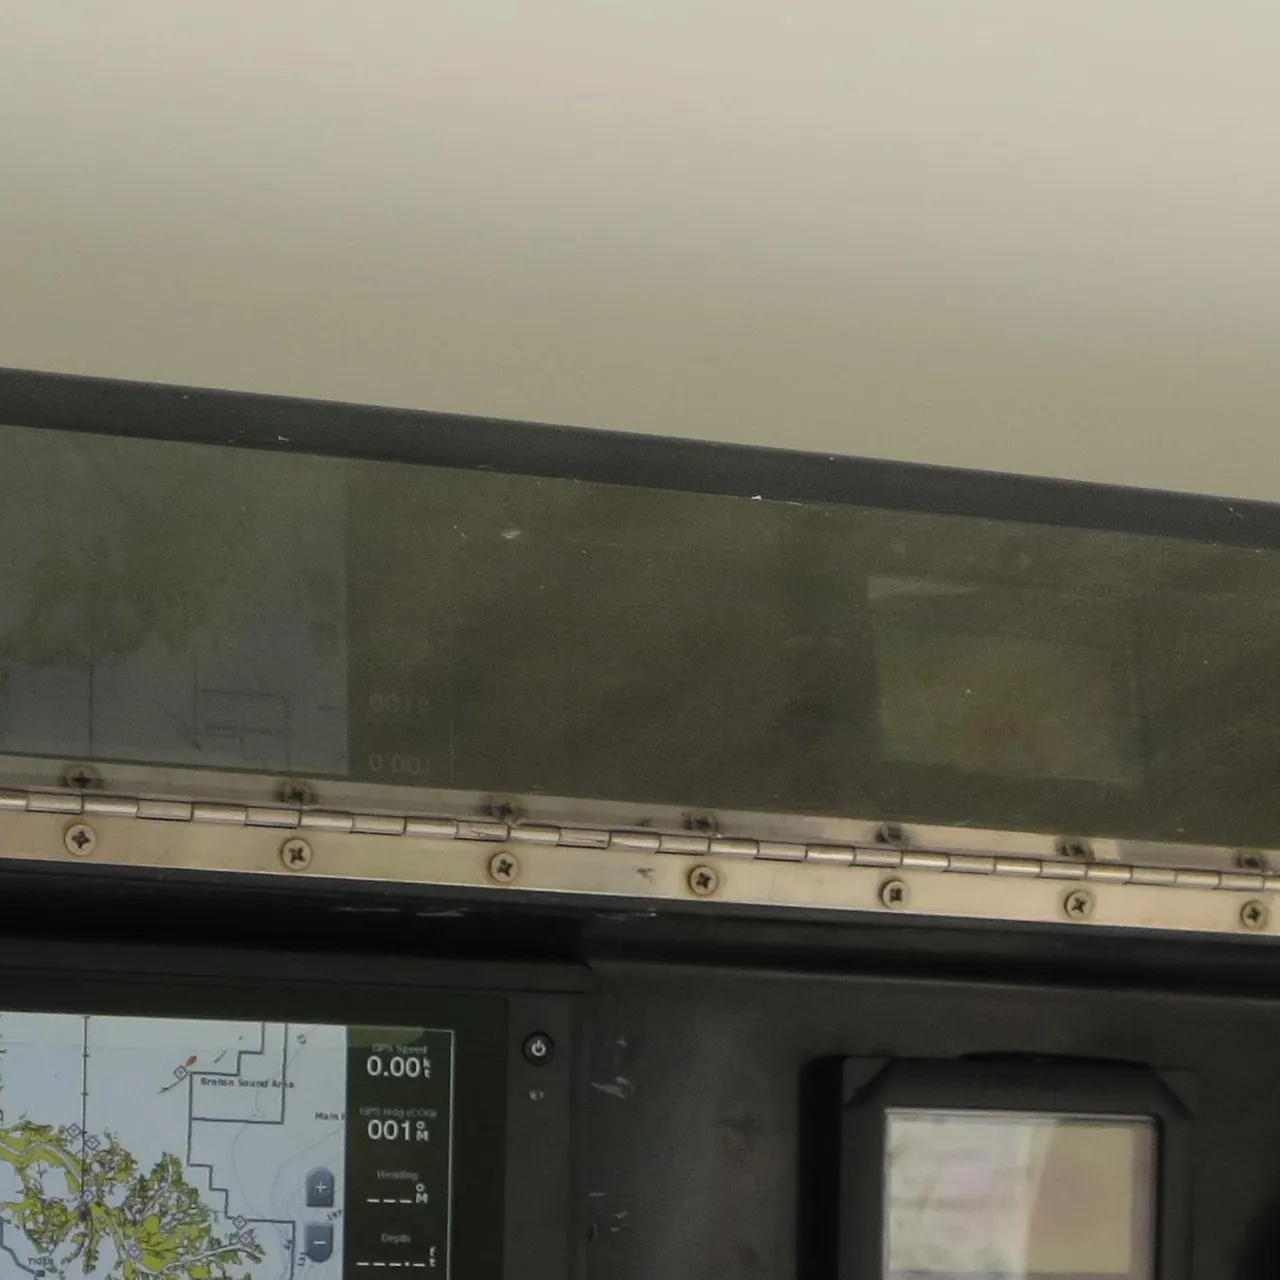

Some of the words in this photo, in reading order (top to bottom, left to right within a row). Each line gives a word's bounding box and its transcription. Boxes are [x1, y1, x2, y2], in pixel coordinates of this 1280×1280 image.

[367, 1055, 420, 1078] 0.00
[238, 1079, 268, 1088] Sound
[271, 1080, 294, 1089] Area
[314, 1111, 339, 1120] Main
[368, 1119, 411, 1141] 001
